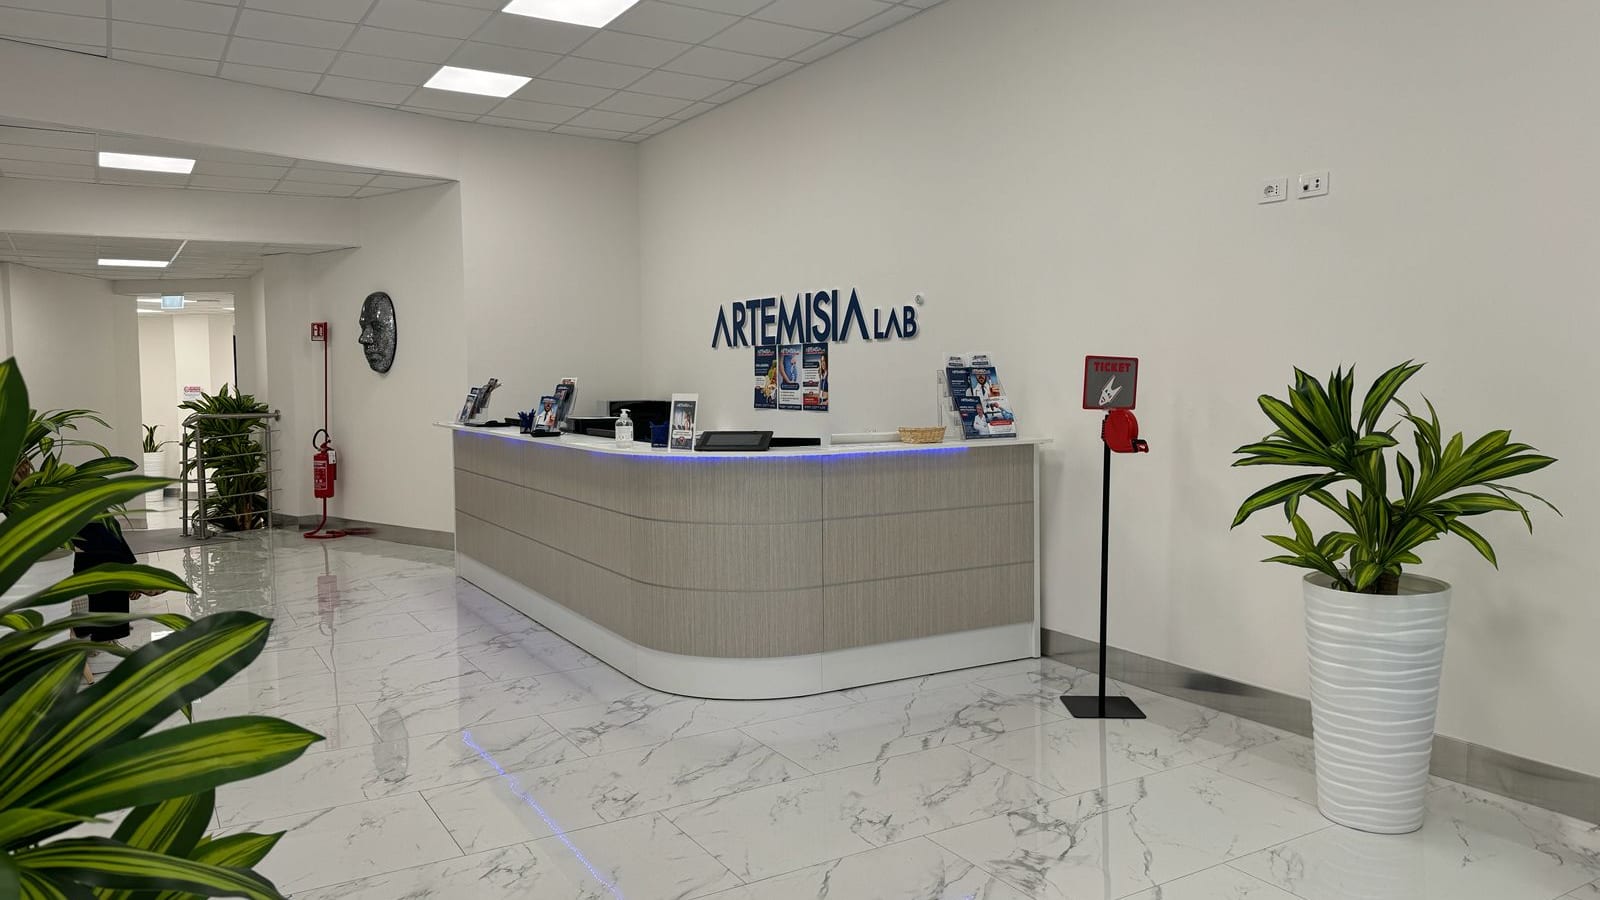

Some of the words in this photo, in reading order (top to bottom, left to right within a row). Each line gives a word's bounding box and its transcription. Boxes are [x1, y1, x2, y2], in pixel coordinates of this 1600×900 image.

[711, 287, 870, 348] ARTEMISIA
[873, 305, 918, 339] LAB
[1093, 361, 1132, 373] TICKET
